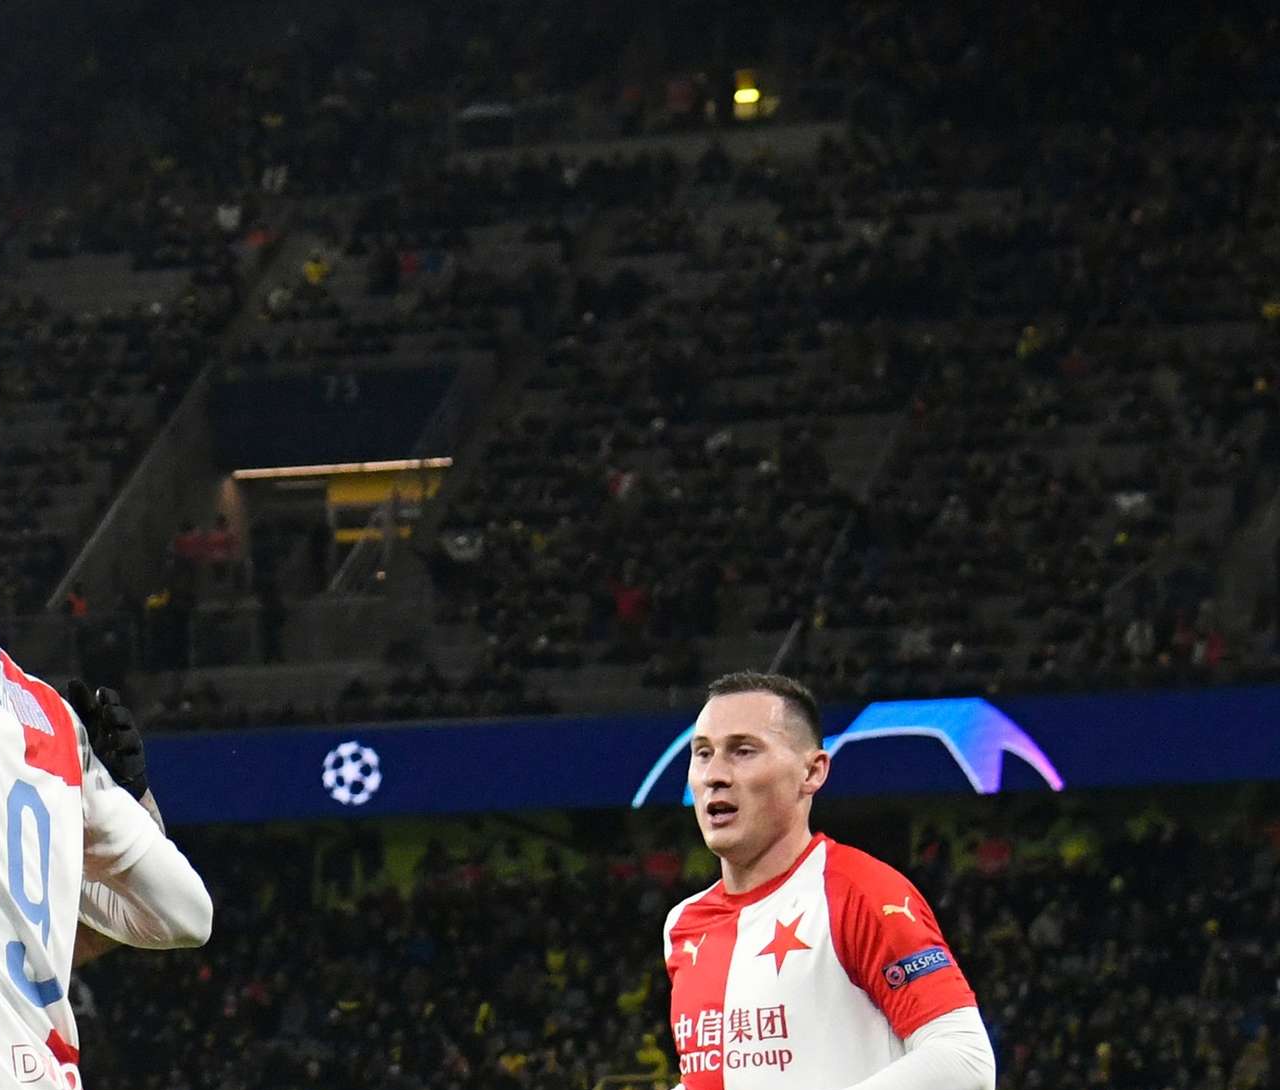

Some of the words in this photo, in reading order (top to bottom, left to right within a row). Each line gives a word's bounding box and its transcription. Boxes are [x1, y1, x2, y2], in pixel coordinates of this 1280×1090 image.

[6, 778, 63, 1008] 9
[903, 951, 946, 975] RESPEC
[673, 1003, 789, 1051] 中信集团
[679, 1049, 722, 1076] CITIC
[726, 1047, 793, 1072] Group
